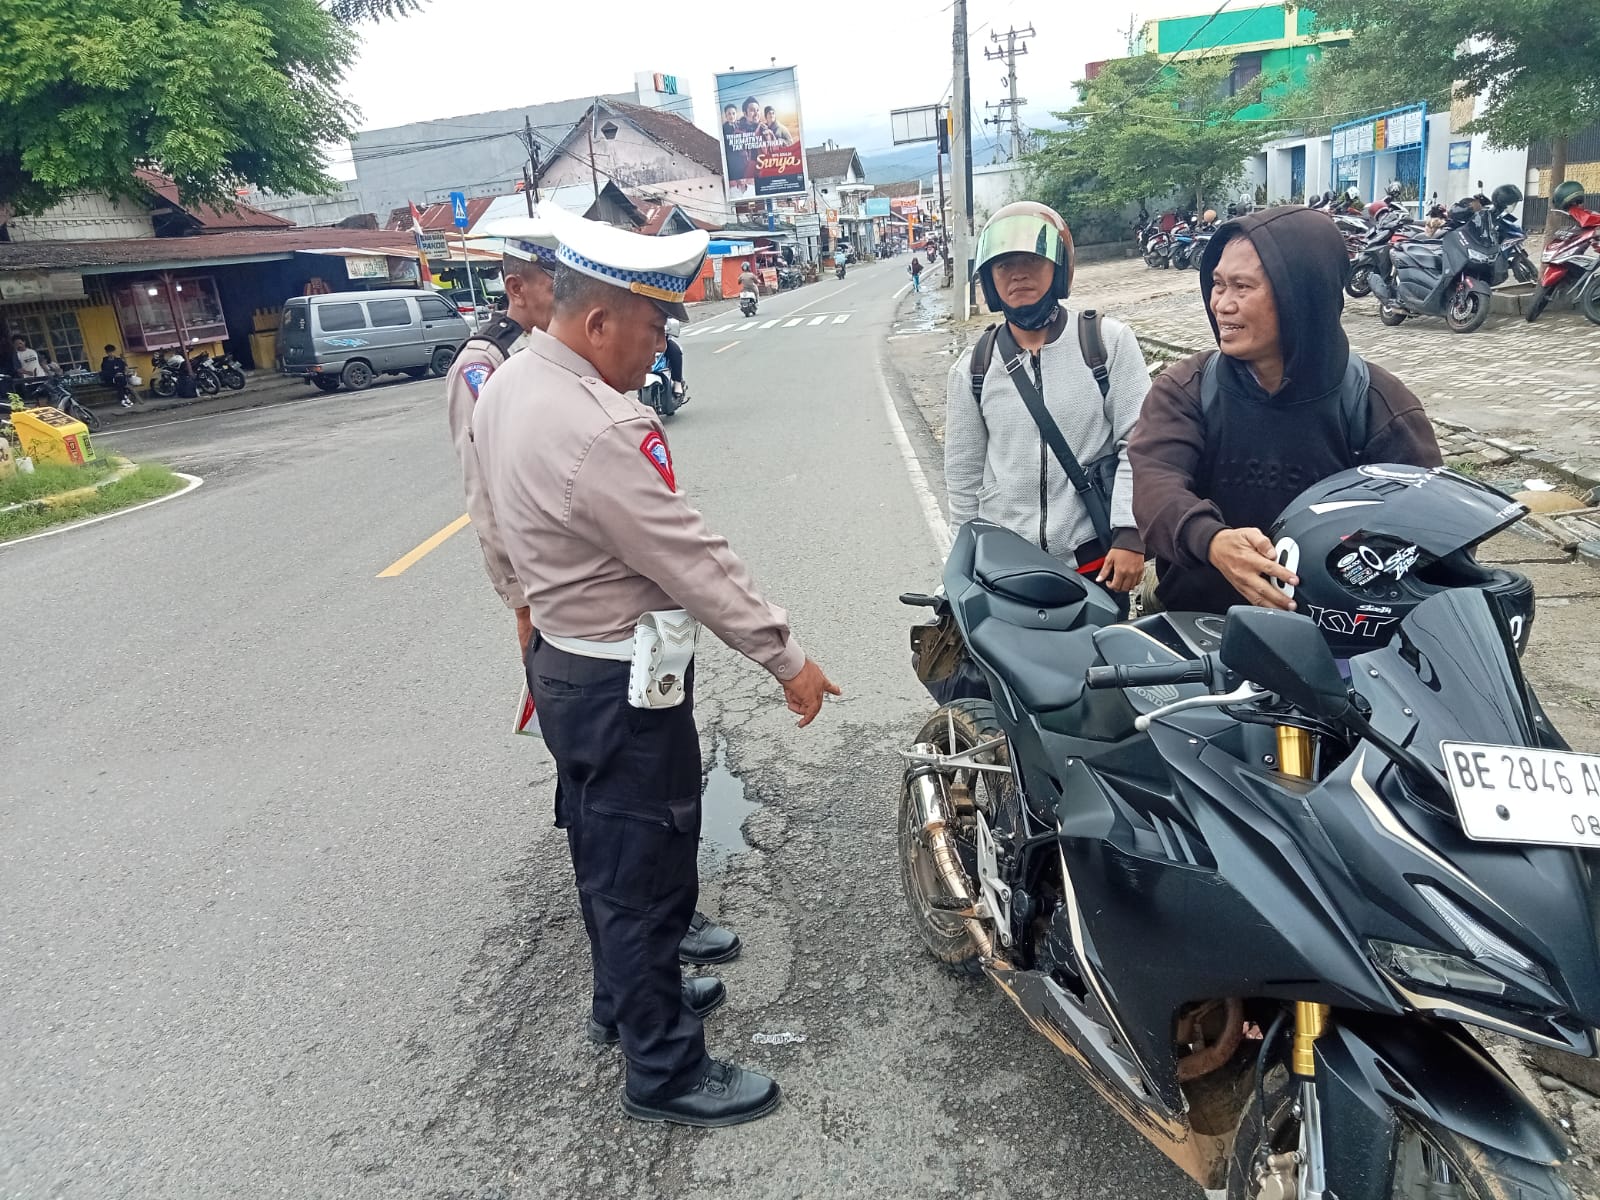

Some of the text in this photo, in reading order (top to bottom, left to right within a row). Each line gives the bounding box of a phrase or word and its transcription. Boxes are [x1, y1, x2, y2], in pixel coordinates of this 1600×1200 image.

[756, 154, 801, 173] Surya
[1129, 687, 1168, 707] OND
[1453, 750, 1495, 789] BE
[1501, 755, 1573, 794] 2846
